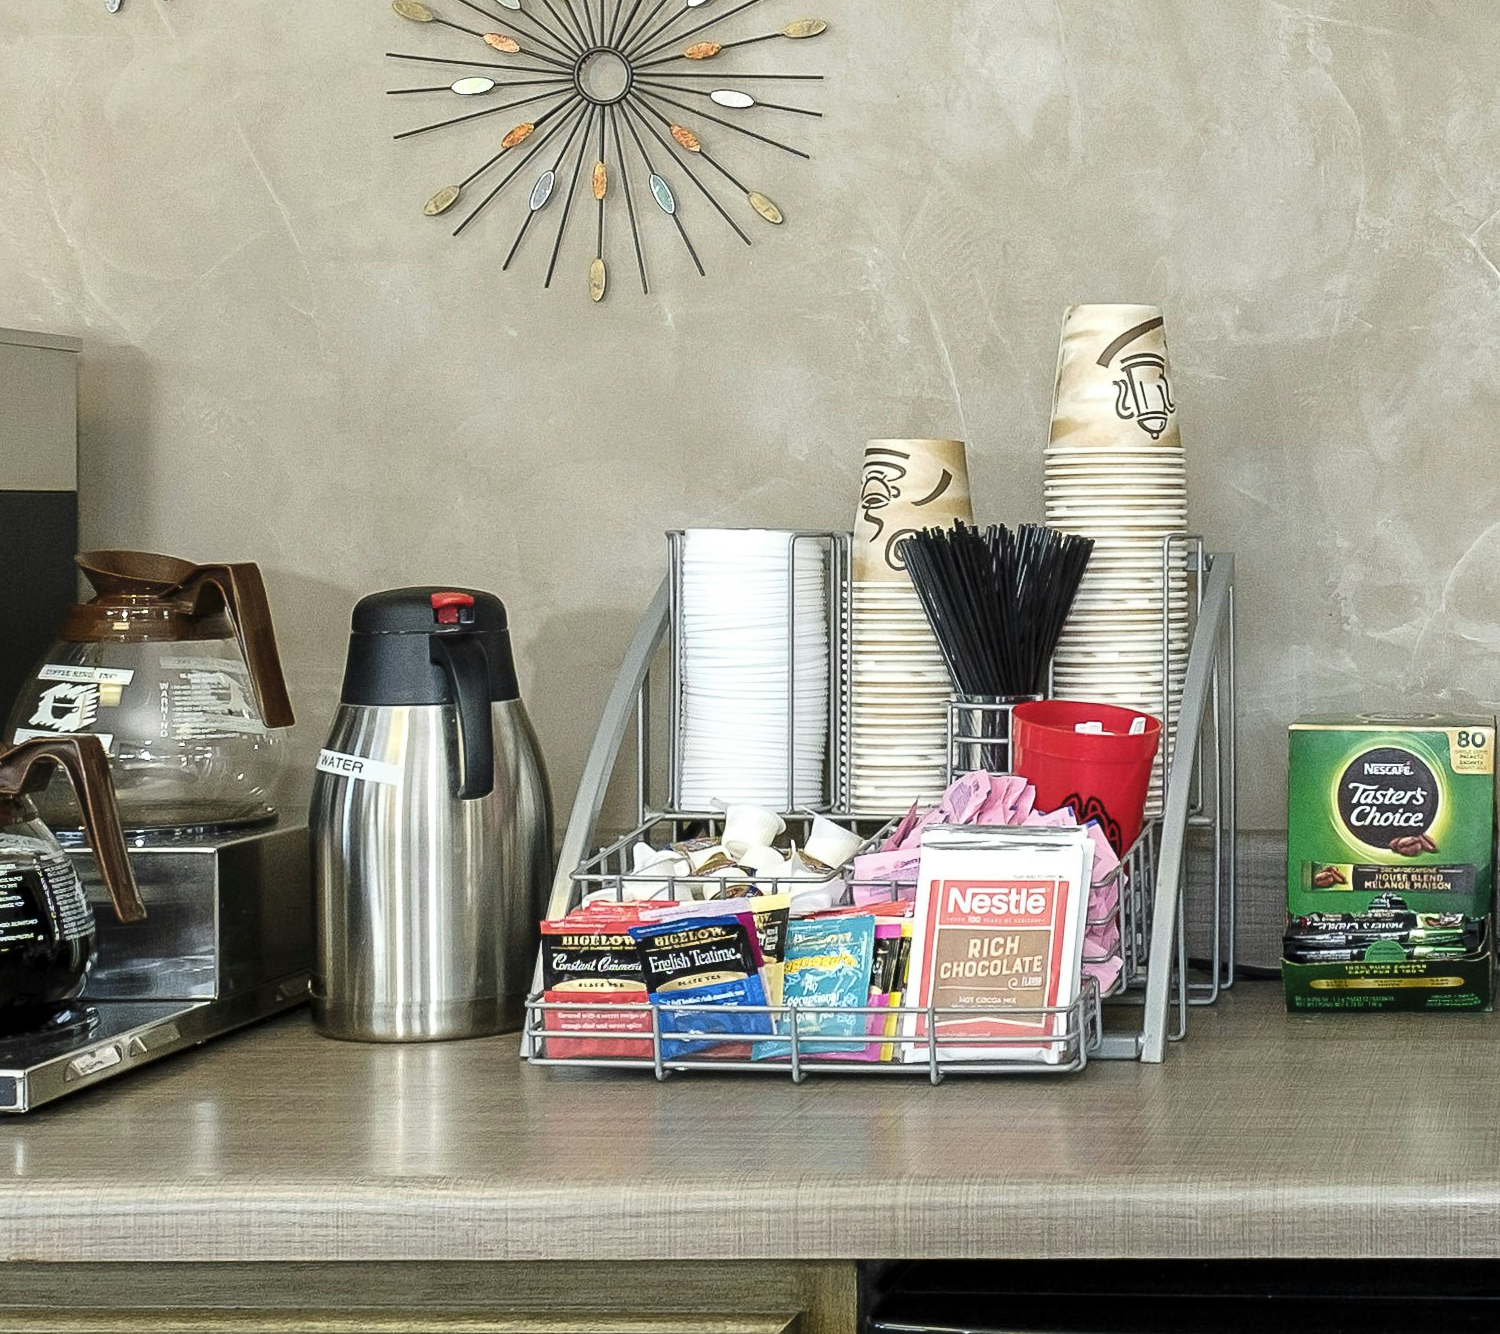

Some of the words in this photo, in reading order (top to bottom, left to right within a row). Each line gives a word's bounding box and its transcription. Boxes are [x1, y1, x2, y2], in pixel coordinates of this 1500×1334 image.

[1457, 730, 1486, 748] 80
[321, 754, 364, 774] WATER
[1364, 761, 1413, 775] NESCAFÉ
[1348, 782, 1428, 805] Taster's
[1350, 806, 1424, 827] Choice
[1374, 874, 1408, 882] HOUSE
[1411, 874, 1444, 882] BLEND
[1414, 881, 1451, 890] MAISON
[947, 886, 1047, 915] Nestlé
[562, 935, 636, 947] BIGELOW
[654, 926, 726, 947] BIGELOW
[967, 935, 1020, 958] RICH
[650, 951, 692, 974] English
[694, 946, 741, 967] Teatime
[939, 955, 1043, 979] CHOCOLATE
[959, 996, 974, 1004] HOT
[1002, 996, 1017, 1004] MIX
